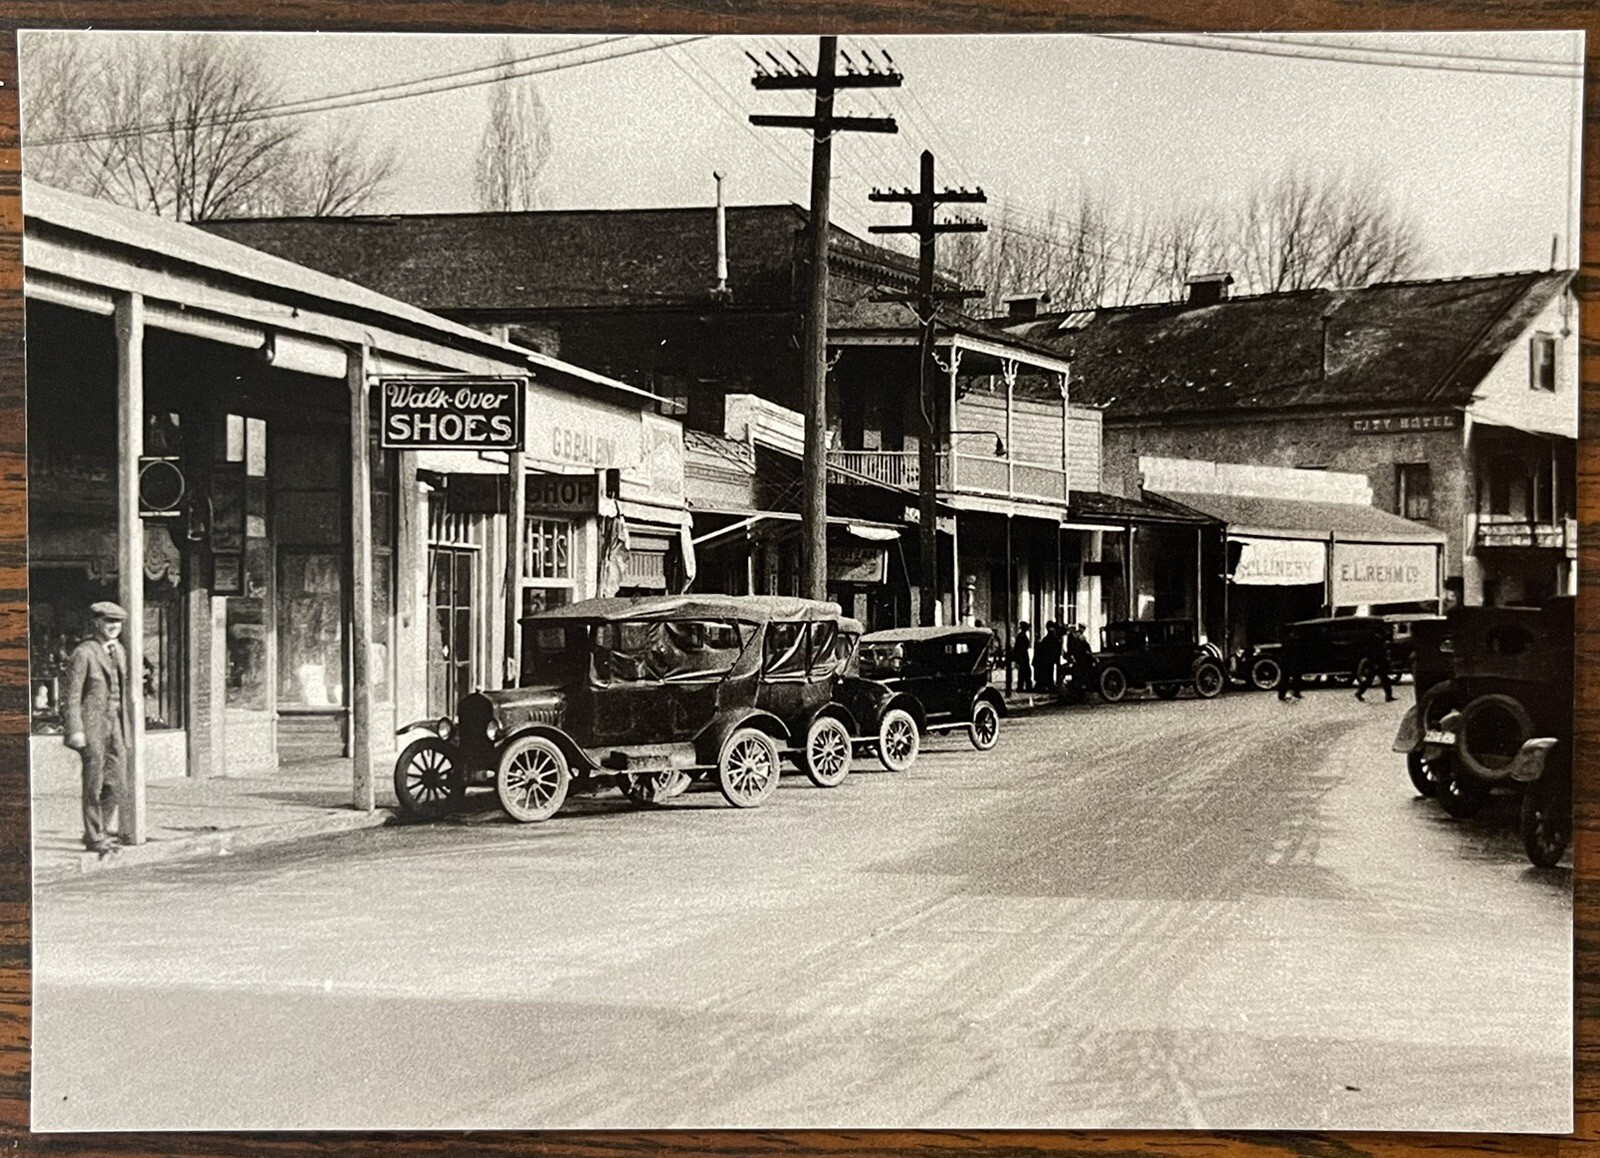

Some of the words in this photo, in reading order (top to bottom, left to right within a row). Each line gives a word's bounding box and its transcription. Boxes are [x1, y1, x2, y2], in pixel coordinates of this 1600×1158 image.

[387, 384, 509, 409] Walk-Over
[388, 413, 512, 441] SHOES
[1353, 419, 1391, 431] CITY
